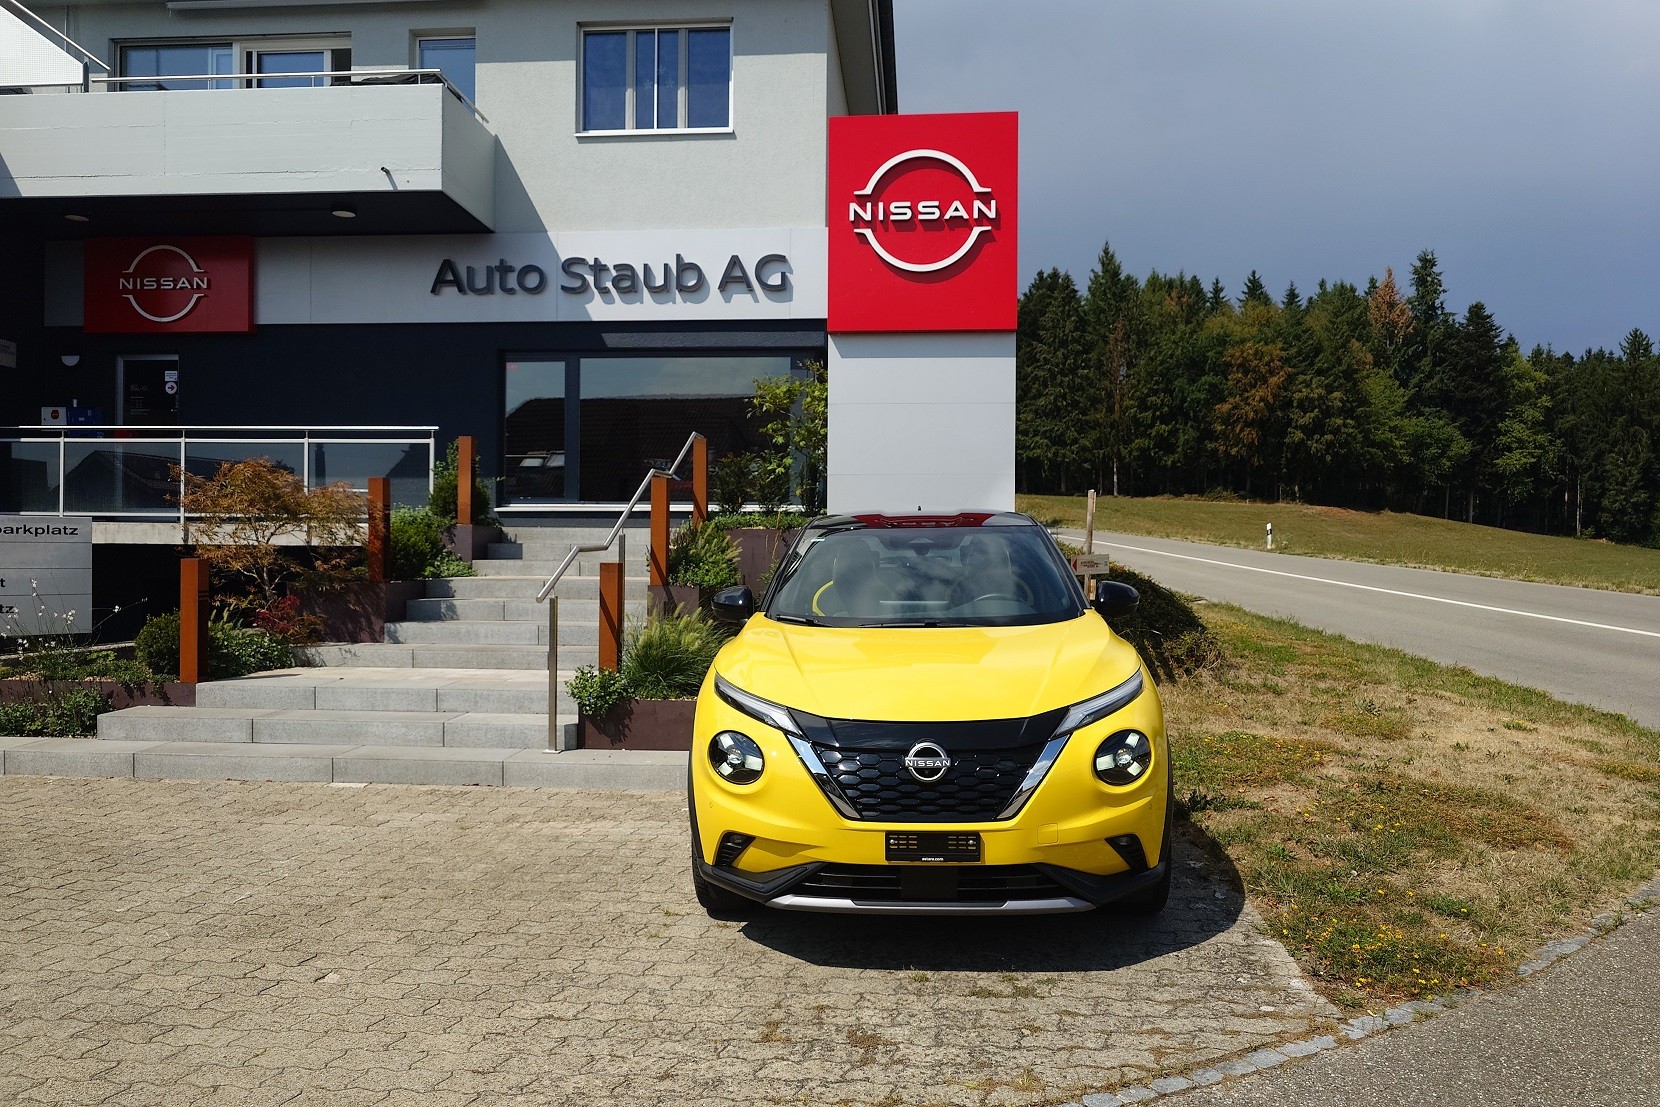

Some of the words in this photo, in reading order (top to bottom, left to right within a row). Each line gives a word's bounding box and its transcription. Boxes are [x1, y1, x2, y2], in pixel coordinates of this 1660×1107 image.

[849, 200, 997, 221] NISSAN
[119, 277, 209, 290] NISSAN
[430, 258, 547, 295] Auto
[560, 254, 702, 294] Staub
[717, 254, 788, 292] AG
